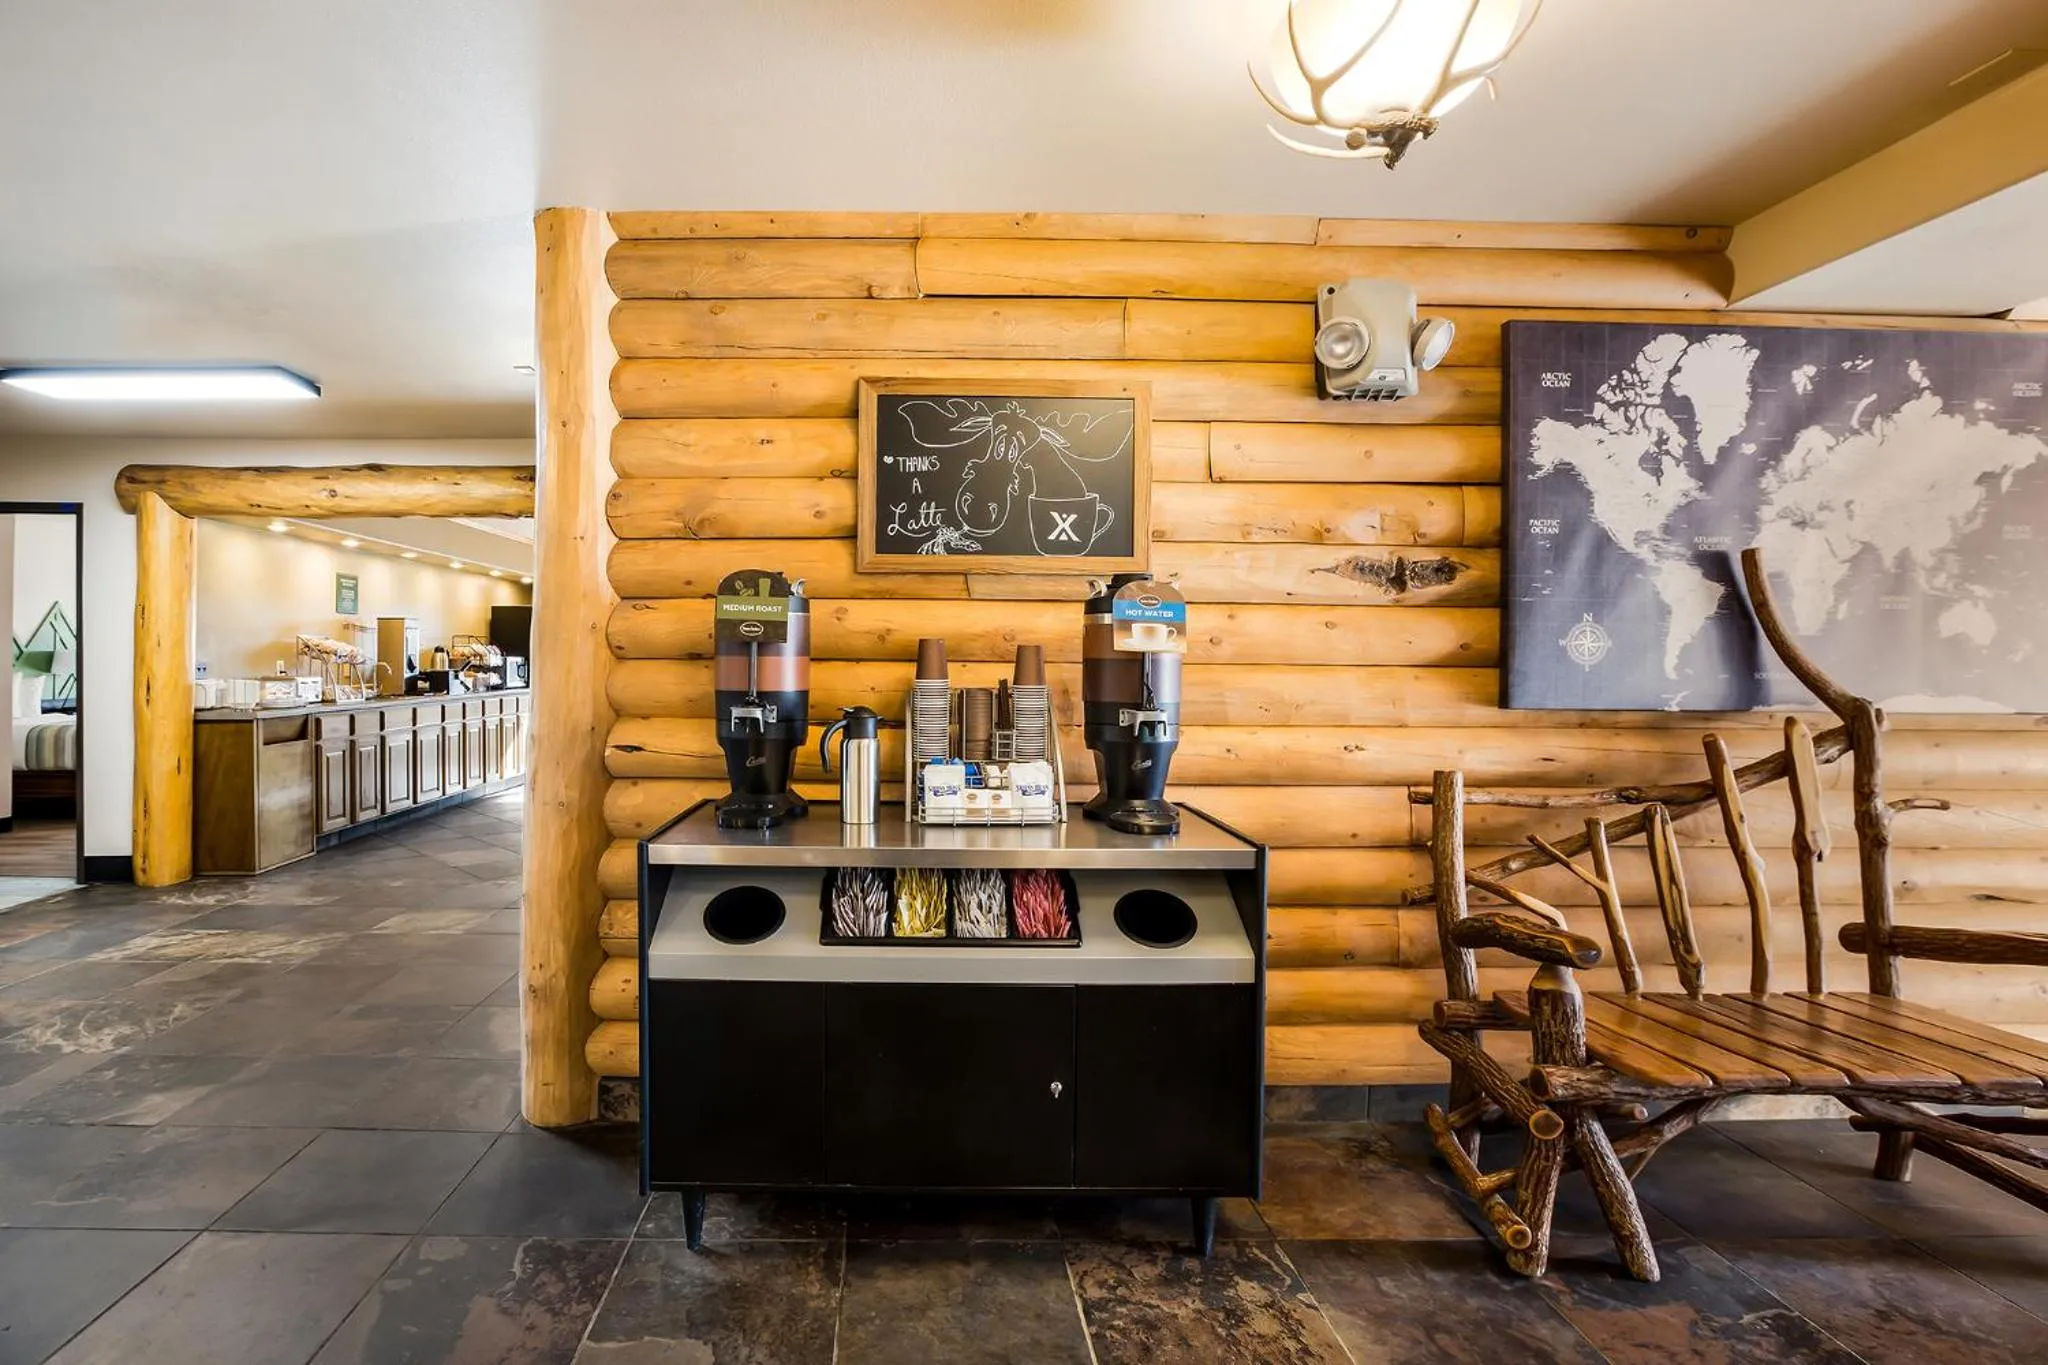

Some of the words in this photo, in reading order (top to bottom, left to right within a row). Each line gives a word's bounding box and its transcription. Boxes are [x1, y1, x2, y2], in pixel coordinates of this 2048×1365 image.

[1541, 372, 1572, 380] ARCTIC
[1541, 380, 1571, 388] OCEAN
[896, 456, 941, 472] THANKS
[912, 478, 922, 494] A
[887, 501, 948, 537] Latte
[1528, 519, 1560, 527] PACIFIC
[1530, 526, 1560, 534] OCEAN
[723, 603, 755, 612] MEDIUM
[755, 604, 783, 613] ROAST
[1125, 609, 1143, 617] HOT
[1144, 609, 1174, 618] WATER
[1583, 612, 1593, 622] N
